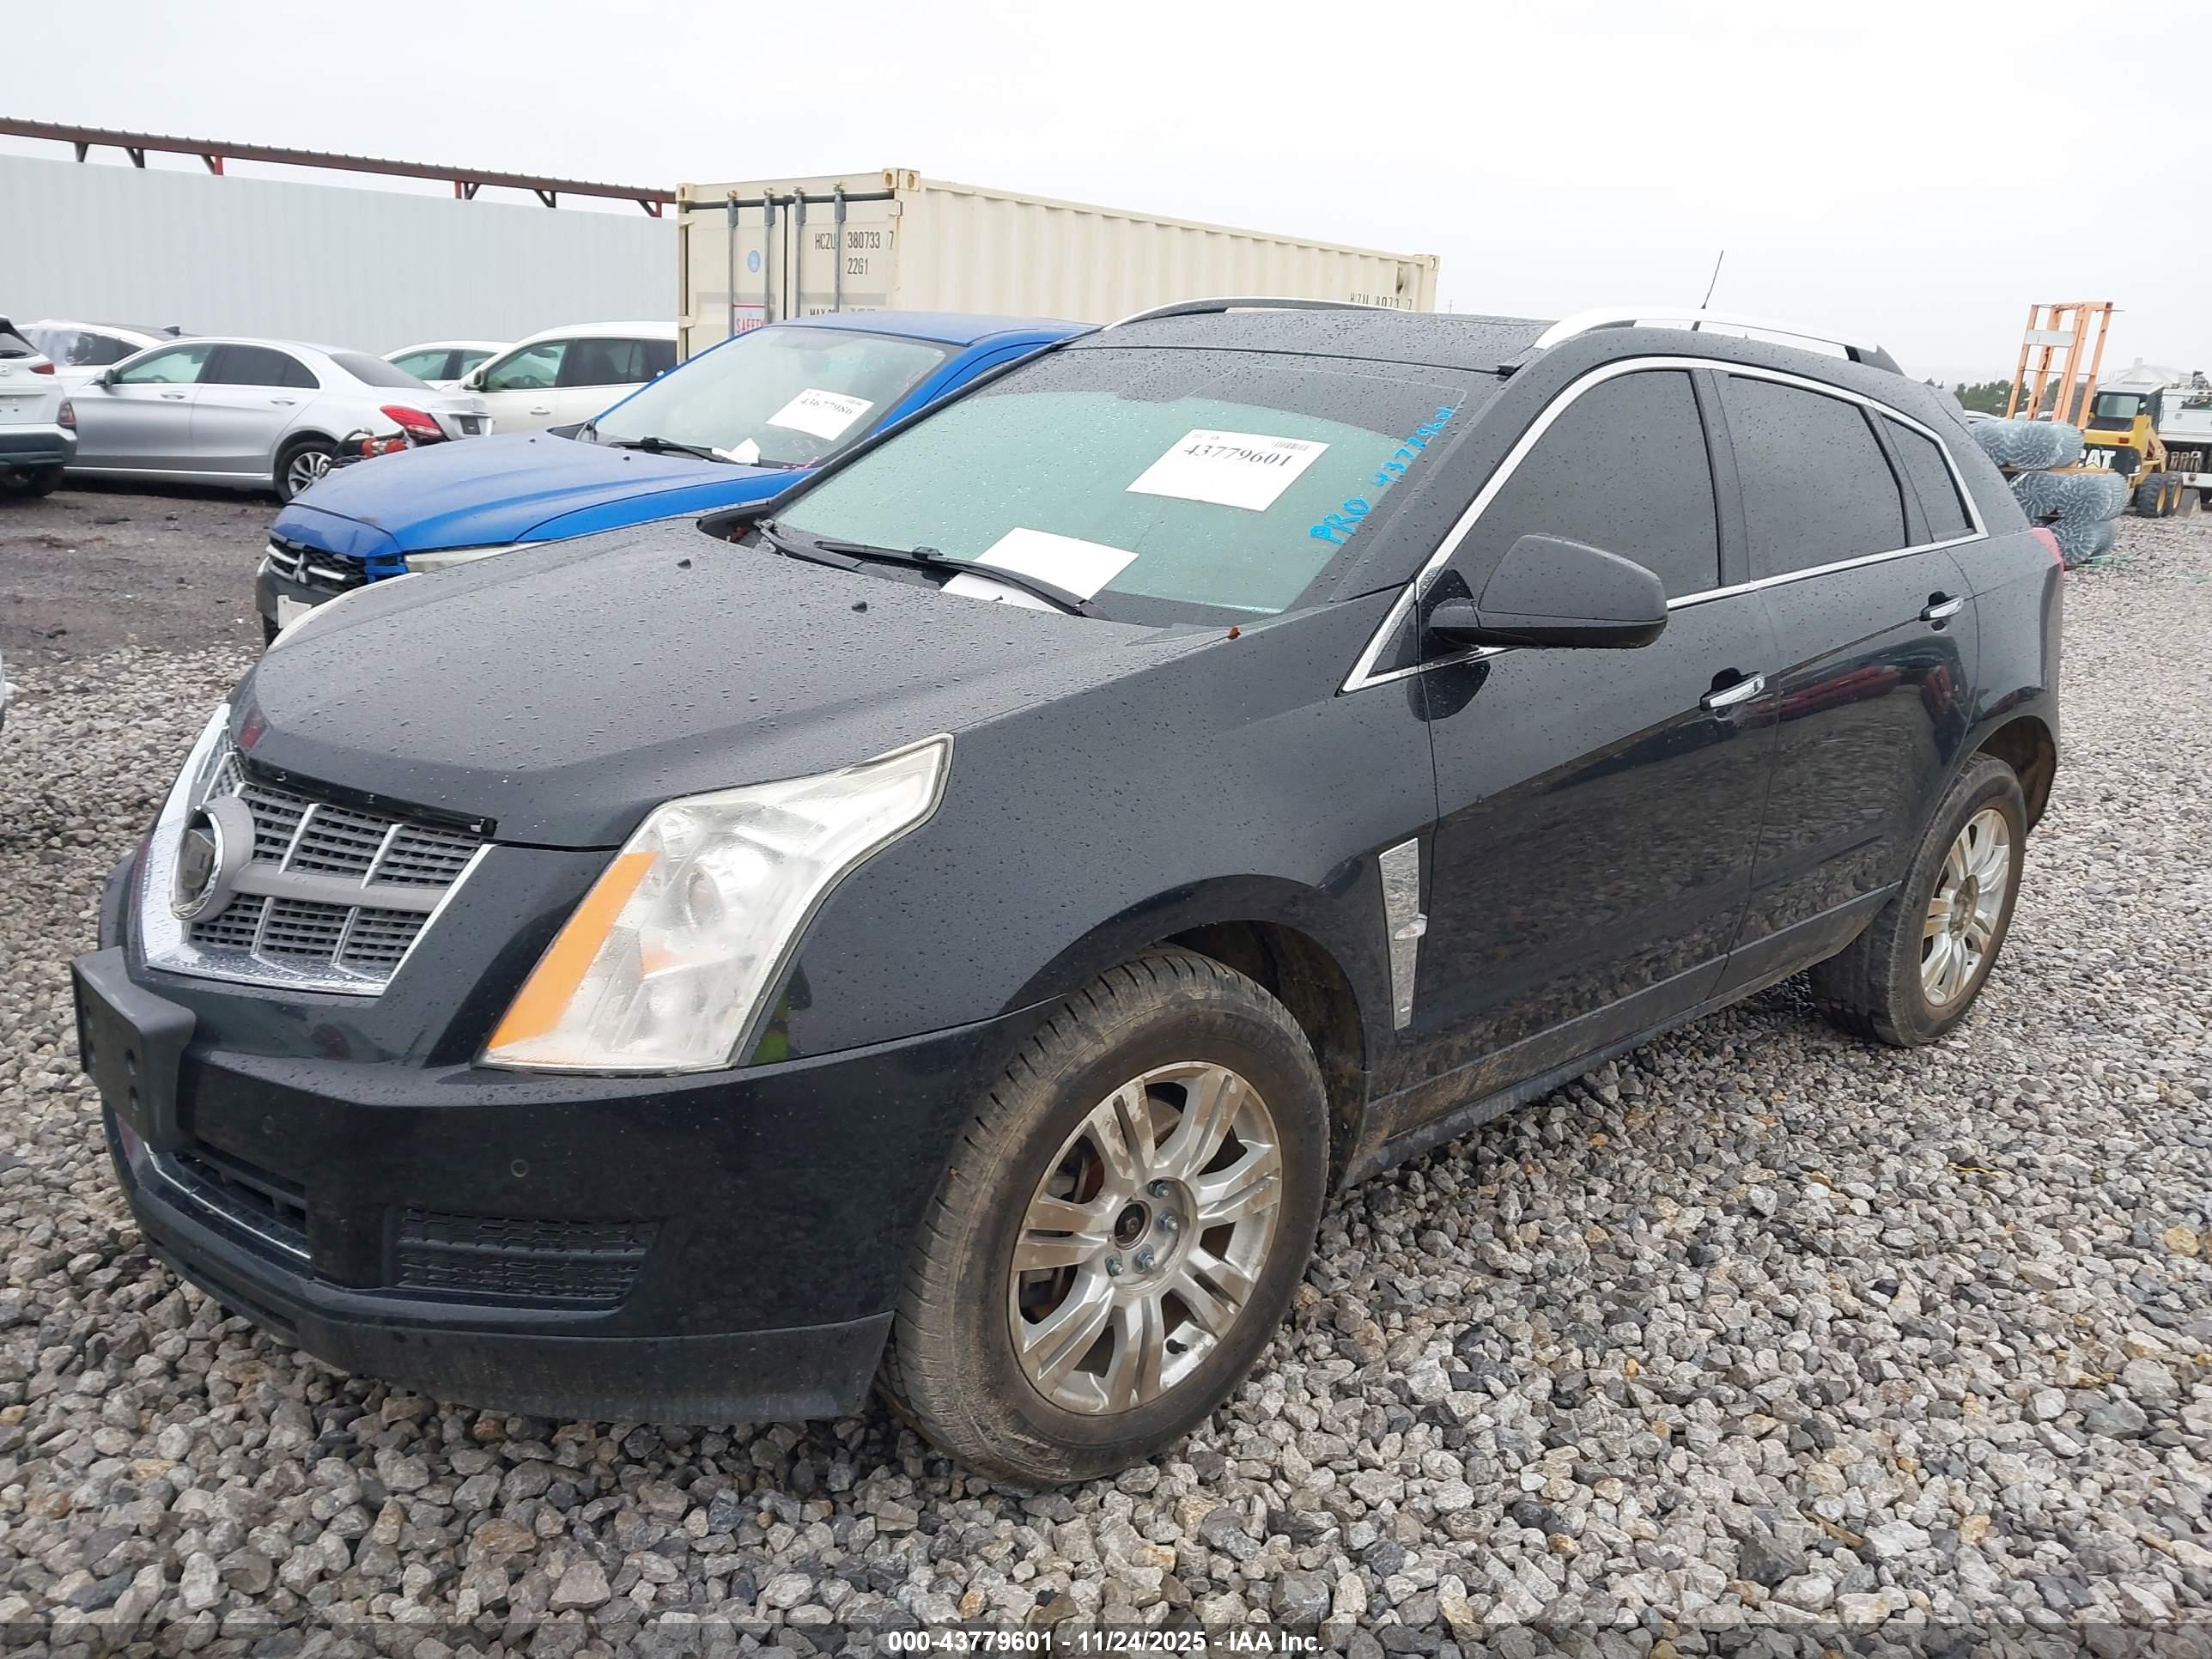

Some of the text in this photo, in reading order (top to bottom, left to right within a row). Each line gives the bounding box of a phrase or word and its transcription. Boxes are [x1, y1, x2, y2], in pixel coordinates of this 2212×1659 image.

[847, 231, 881, 249] 380733
[887, 230, 895, 249] 7
[847, 257, 868, 275] 22G1
[1184, 443, 1293, 466] 43779601
[1309, 497, 1370, 545] PRO
